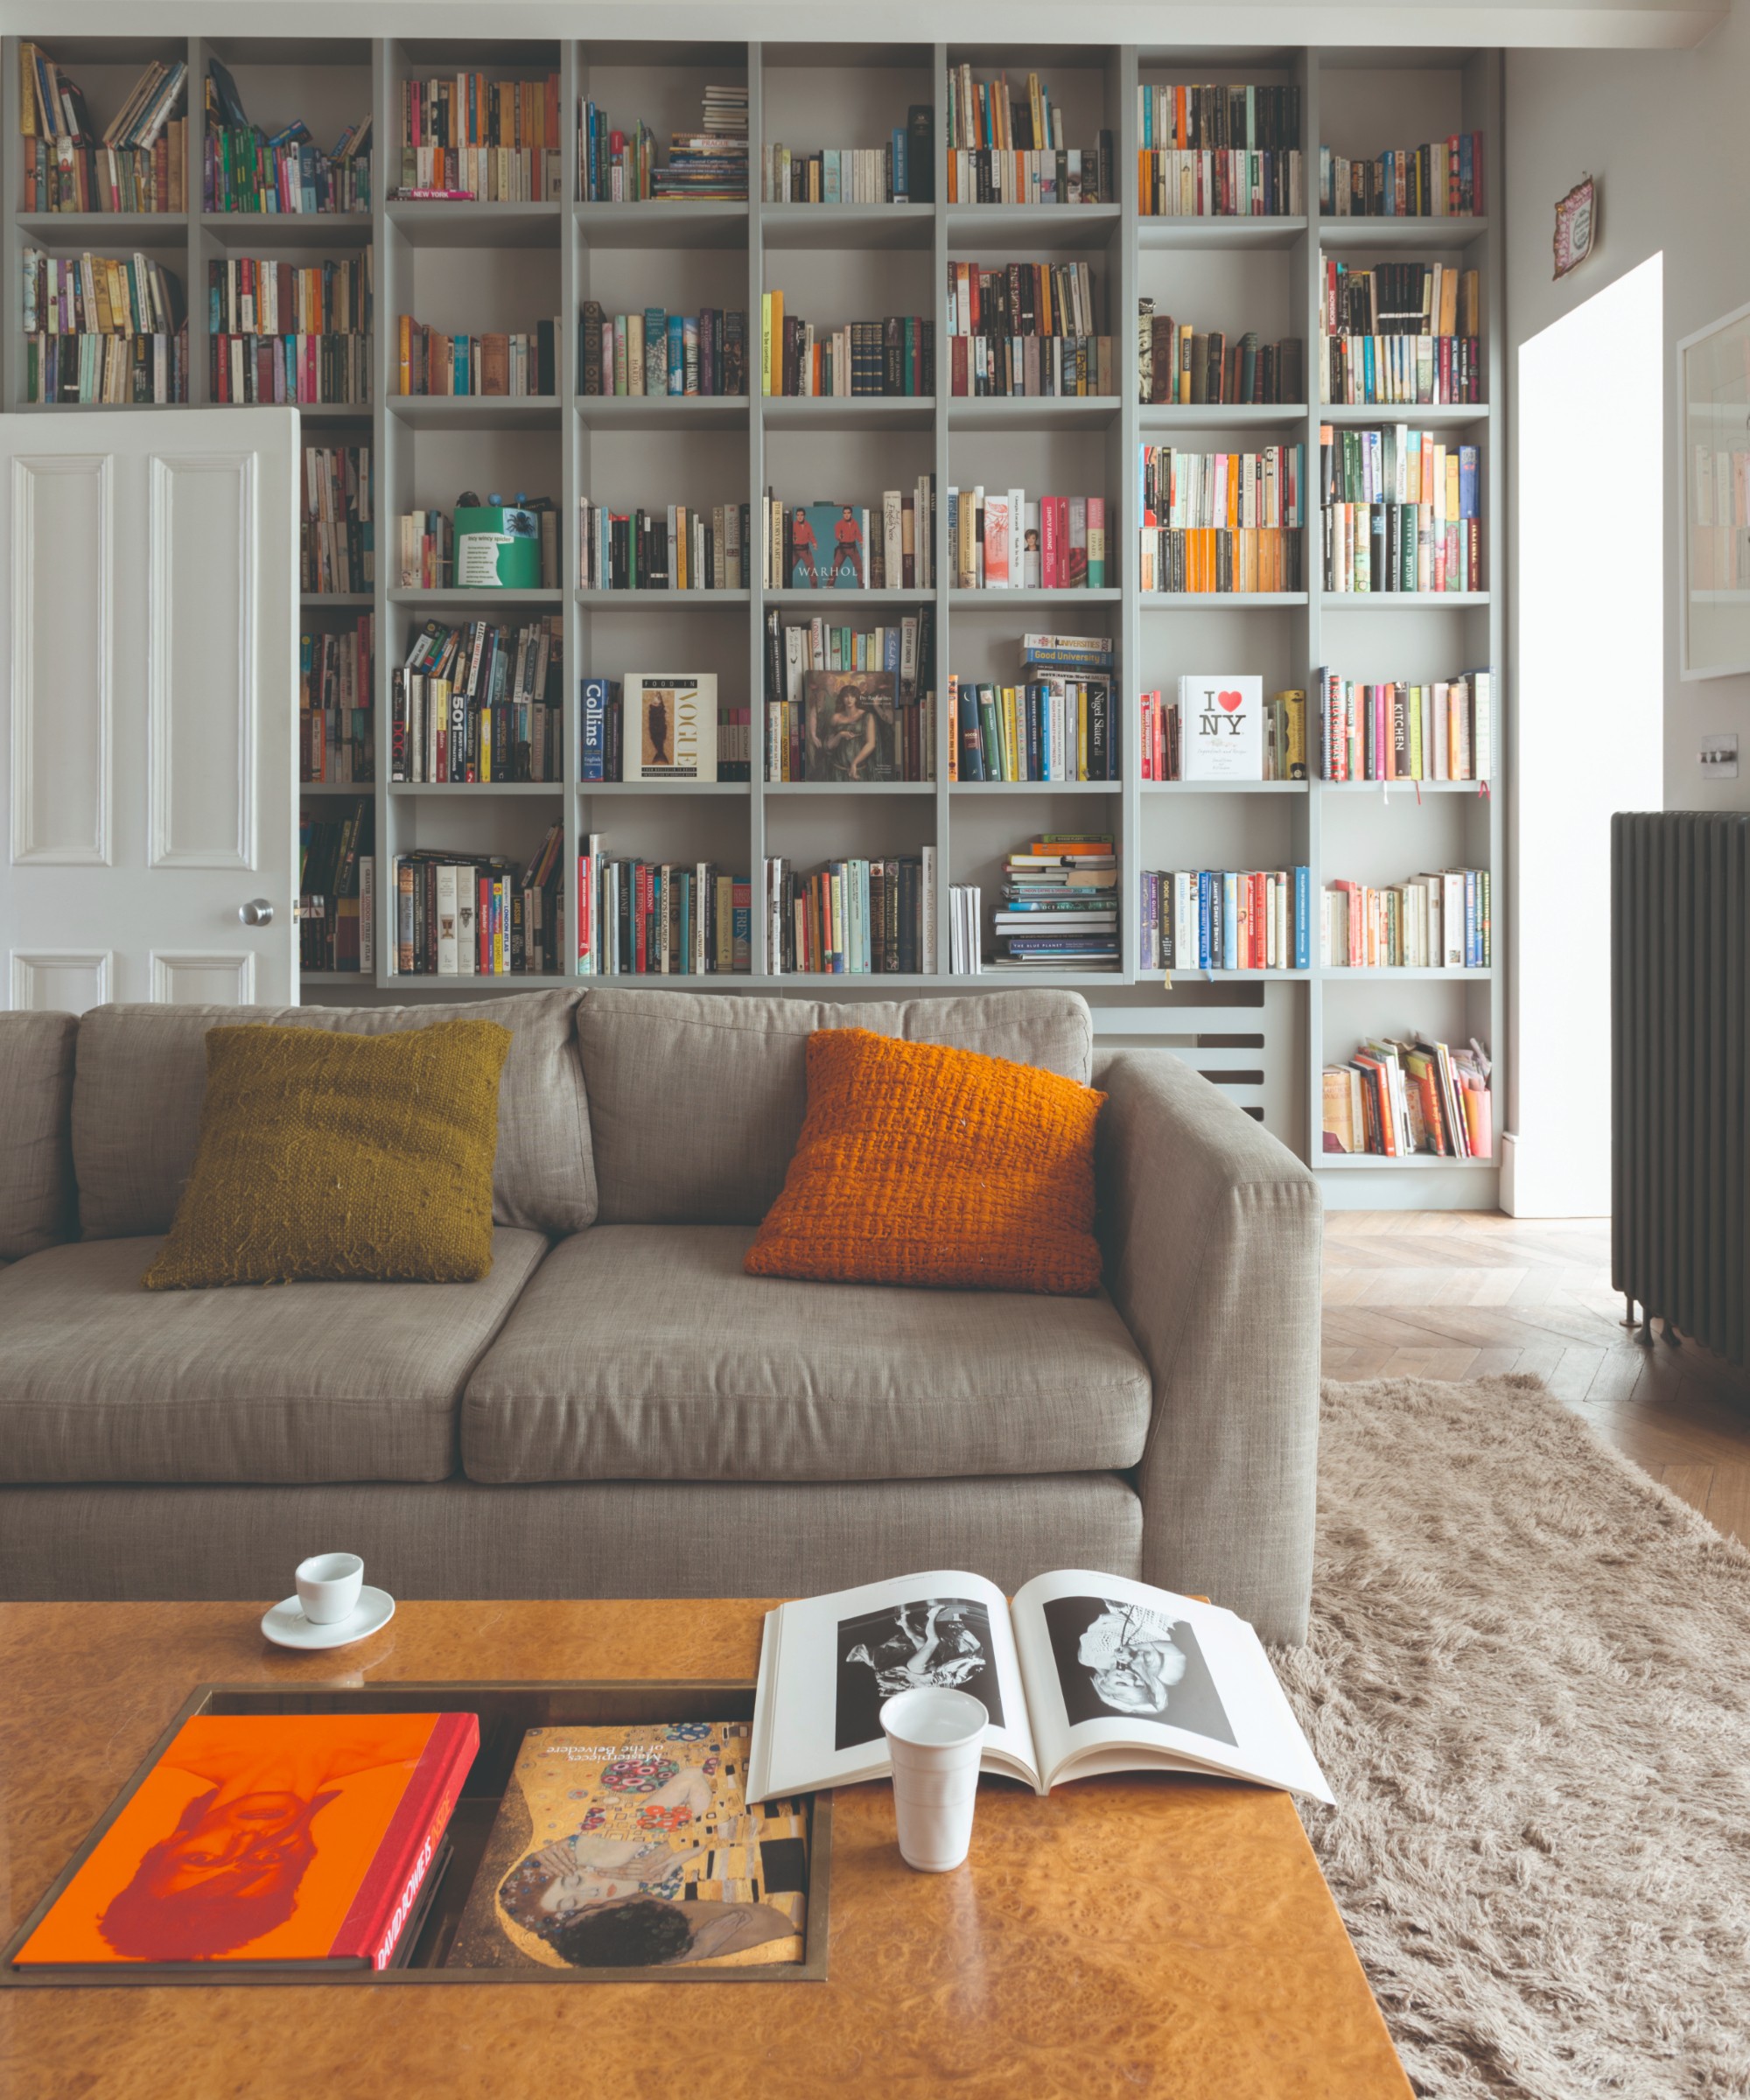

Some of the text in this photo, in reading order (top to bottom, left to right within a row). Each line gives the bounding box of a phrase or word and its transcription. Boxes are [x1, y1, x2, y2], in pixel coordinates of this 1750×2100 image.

[301, 158, 313, 178] Italy
[413, 190, 449, 200] NEW YORK
[1009, 266, 1020, 316] ZADIE SMITH
[617, 334, 626, 383] KIRAN DESAI
[1077, 354, 1087, 382] Pelé
[1245, 462, 1254, 493] SHELLEY
[886, 504, 897, 541] English Verse
[948, 494, 957, 528] JERUSALEM
[774, 538, 781, 547] OF
[797, 566, 859, 578] WARHOL
[812, 623, 821, 649] LONDON
[1058, 639, 1101, 648] UNIVERSITIES
[1034, 650, 1101, 665] Good University
[452, 696, 464, 731] 501
[585, 683, 603, 746] Collins
[1090, 690, 1104, 746] Nigel Slater
[1203, 690, 1215, 712] I
[393, 720, 404, 757] DOG
[534, 713, 542, 765] GREAT BRITAIN
[676, 691, 698, 766] VOGUE
[1198, 714, 1247, 736] NY
[1332, 686, 1340, 760] NIGELLA CHRISTMAS
[1394, 703, 1404, 751] KITCHEN
[635, 870, 644, 912] MILLER'S
[736, 910, 747, 956] FRENCH
[545, 1744, 664, 1755] of the Belvedere
[564, 1752, 662, 1764] Masterpieces
[377, 1907, 403, 1970] DAVID
[402, 1852, 428, 1914] BOWIE
